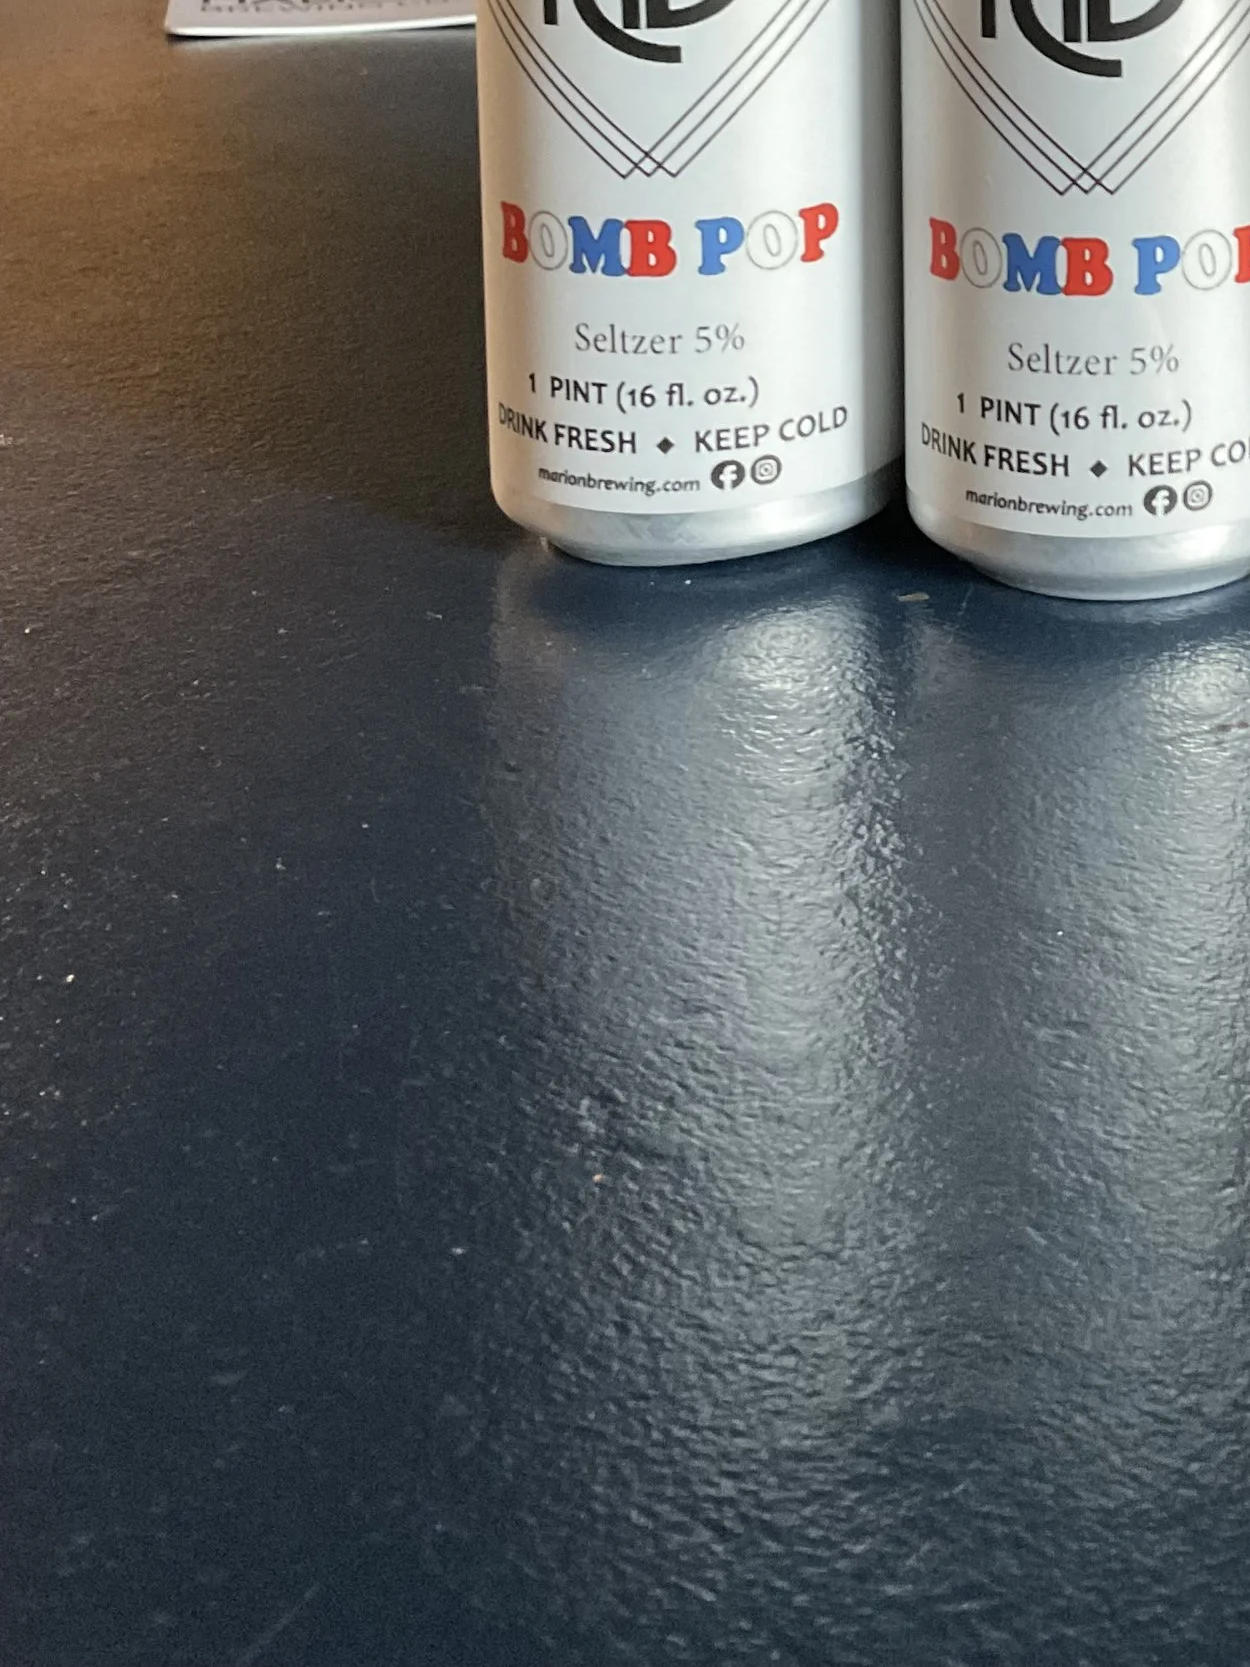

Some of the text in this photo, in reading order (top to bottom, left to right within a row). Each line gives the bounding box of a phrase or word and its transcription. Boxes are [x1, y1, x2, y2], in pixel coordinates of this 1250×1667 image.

[500, 201, 839, 277] BOMB POP
[929, 217, 1114, 296] BOMB
[574, 322, 746, 355] Seltzer 5%
[1007, 342, 1180, 377] Seltzer 5%
[528, 372, 759, 414] 1 PINT (16 fl. oz.)
[956, 392, 1193, 436] 1 PINT (16 fl. oz.)
[498, 401, 848, 454] DRINK FRESH KEEP COLD
[921, 422, 977, 465] DRINK
[984, 445, 1070, 478] FRESH
[1128, 448, 1201, 478] KEEP
[538, 465, 700, 497] marionbrewing.com
[966, 487, 1133, 521] marionbrewing.com
